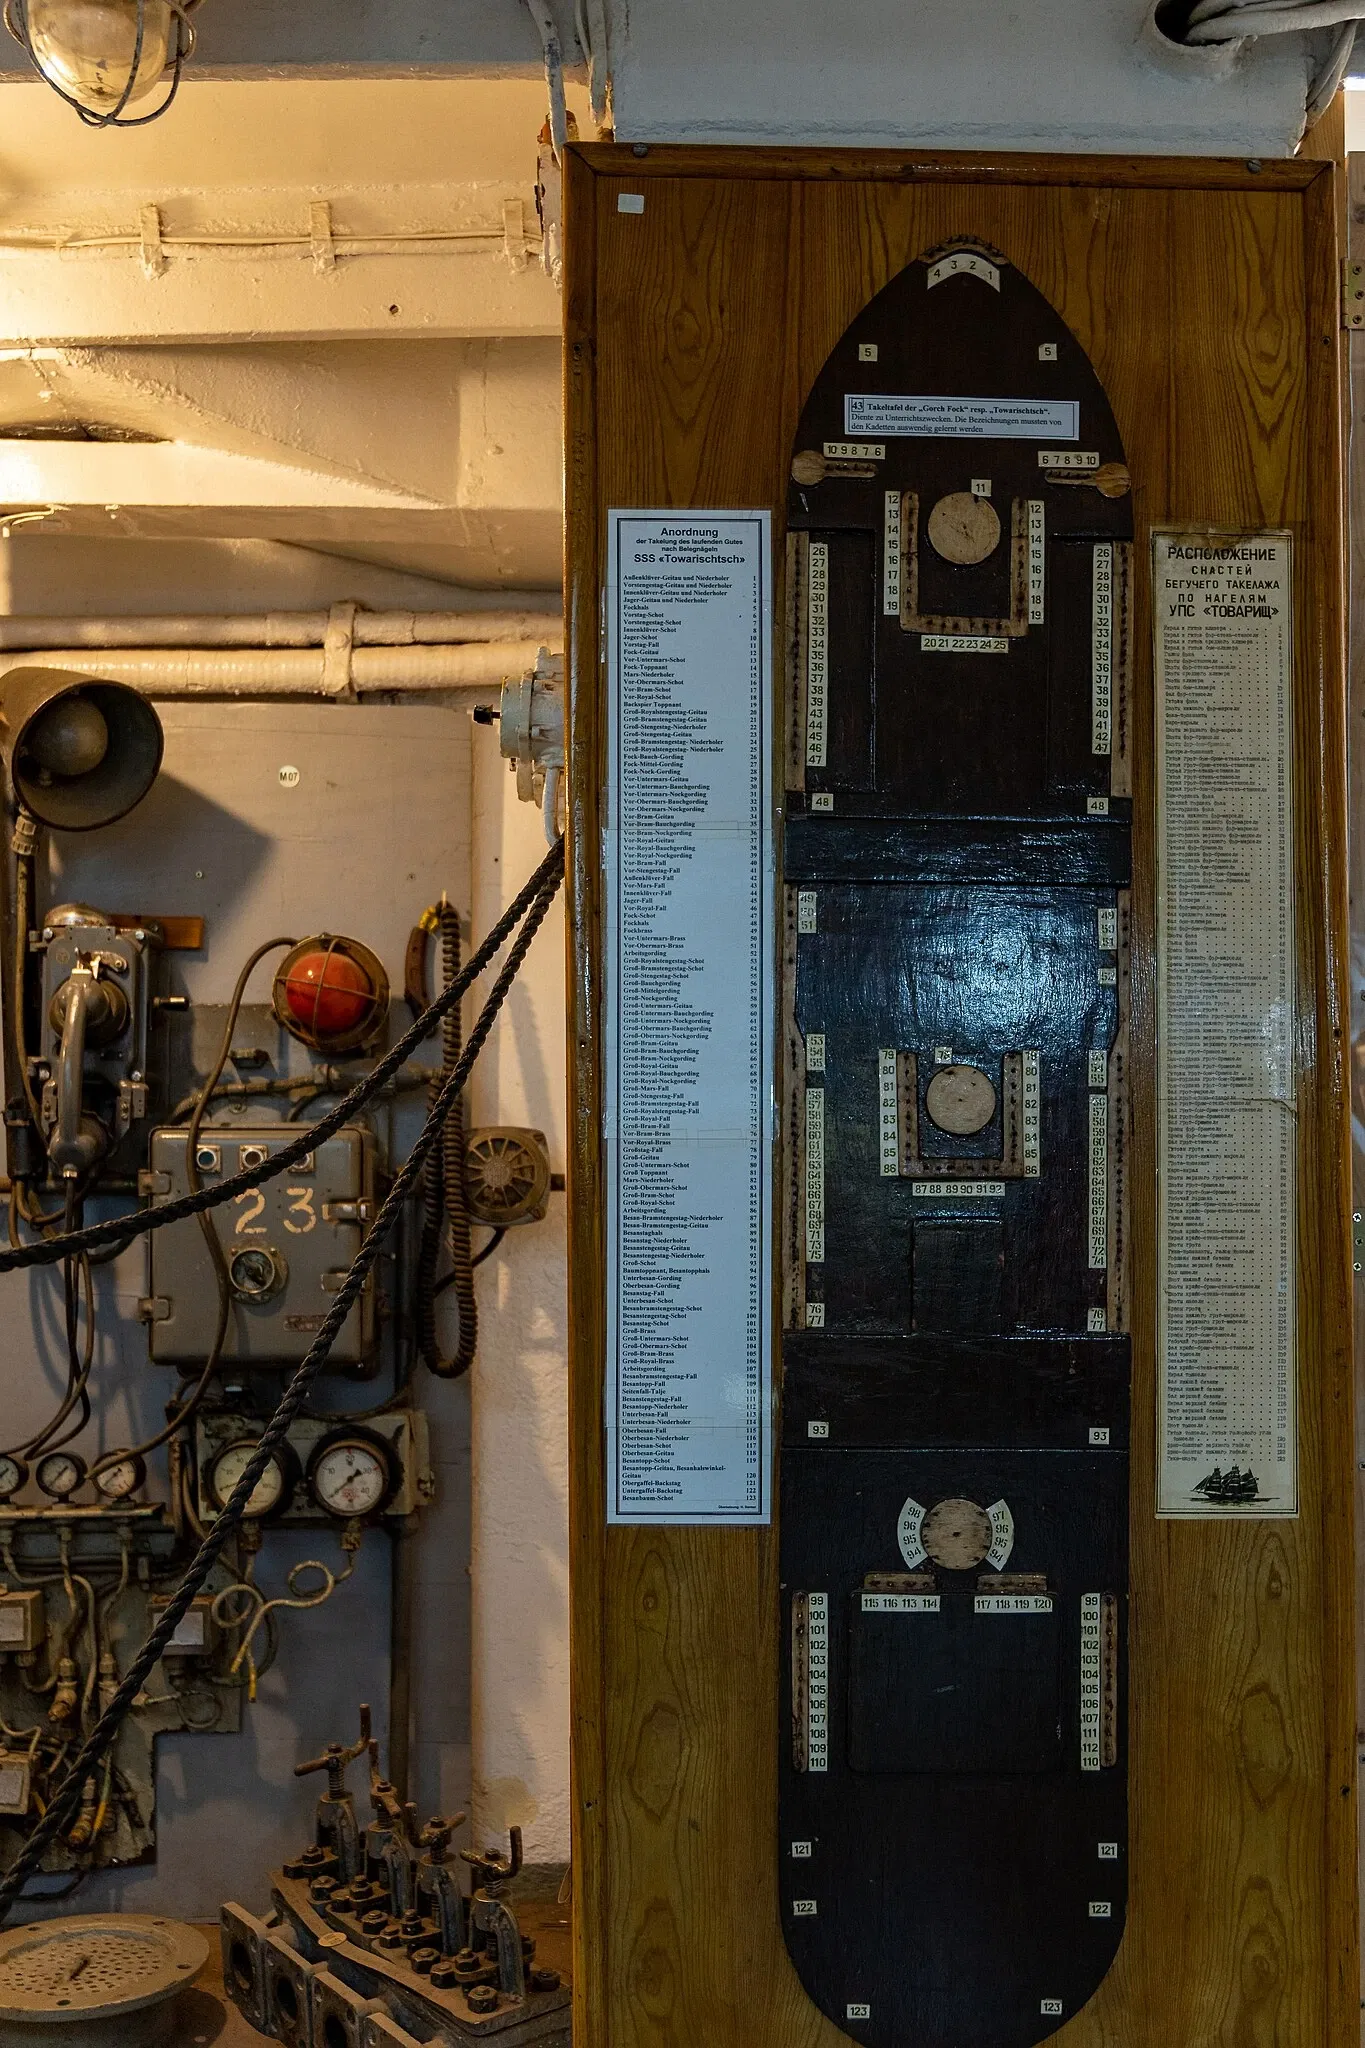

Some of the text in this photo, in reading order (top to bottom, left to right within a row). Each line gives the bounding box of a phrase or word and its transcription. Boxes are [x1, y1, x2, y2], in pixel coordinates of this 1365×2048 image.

[934, 269, 940, 278] 4
[951, 261, 957, 269] 3
[970, 261, 976, 269] 2
[864, 348, 871, 357] 5
[1045, 347, 1051, 356] 5
[852, 401, 863, 410] 43
[867, 403, 903, 412] Takeltafel
[905, 404, 917, 412] der
[852, 413, 874, 421] Diente
[885, 414, 952, 423] Unterrichtszwecken.
[968, 416, 1019, 425] Bezeichnungen
[865, 423, 896, 431] Kadetten
[897, 424, 933, 433] auswendig
[934, 425, 957, 433] gelernt
[828, 445, 881, 456] 10 9 8 7 6
[1042, 456, 1096, 465] 6 7 8 9 10
[976, 484, 986, 492] 11
[888, 495, 899, 504] 12
[888, 510, 899, 519] 13
[661, 528, 718, 538] Anordnung
[888, 525, 899, 534] 14
[888, 540, 898, 549] 15
[1168, 547, 1276, 560] РАСПОЛОЖЕНИЕ
[634, 554, 745, 564] SSS «Towarischtsch»
[889, 555, 898, 564] 16
[1191, 564, 1252, 575] СНАСТЕЙ
[889, 570, 898, 579] 17
[1165, 579, 1280, 589] БЕГУЧЕГО ТАКЕЛАЖА
[888, 586, 898, 594] 18
[1178, 594, 1266, 603] ПО НАГЕЛЯМ
[887, 601, 898, 610] 19
[1169, 605, 1279, 619] УПС «ТОВАРИЩ»
[924, 638, 1006, 650] 20 21 22 23 24 25
[279, 772, 297, 781] M 07
[816, 797, 829, 806] 48
[1091, 801, 1104, 810] 48
[883, 1050, 894, 1059] 79
[882, 1066, 894, 1075] 80
[883, 1082, 894, 1090] 81
[883, 1098, 895, 1107] 82
[883, 1114, 895, 1123] 83
[883, 1131, 896, 1140] 84
[883, 1148, 896, 1157] 85
[884, 1164, 896, 1173] 86
[915, 1184, 1002, 1194] 87 88 89 90 91 92
[812, 1425, 826, 1435] 93
[1093, 1431, 1107, 1441] 93
[908, 1506, 921, 1519] 98
[992, 1510, 1005, 1521] 97
[903, 1521, 916, 1531] 96
[995, 1524, 1009, 1534] 96
[903, 1534, 917, 1544] 95
[994, 1537, 1008, 1548] 95
[907, 1547, 921, 1560] 94
[989, 1548, 1003, 1563] 94
[864, 1598, 879, 1607] 115
[883, 1599, 898, 1608] 116
[922, 1599, 937, 1608] 114
[977, 1600, 1051, 1609] 117 118 119 120
[794, 1845, 809, 1855] 121
[1100, 1846, 1115, 1855] 121
[796, 1903, 813, 1912] 122
[1091, 1905, 1108, 1914] 122
[850, 2006, 867, 2016] 123
[1043, 2002, 1061, 2012] 123
